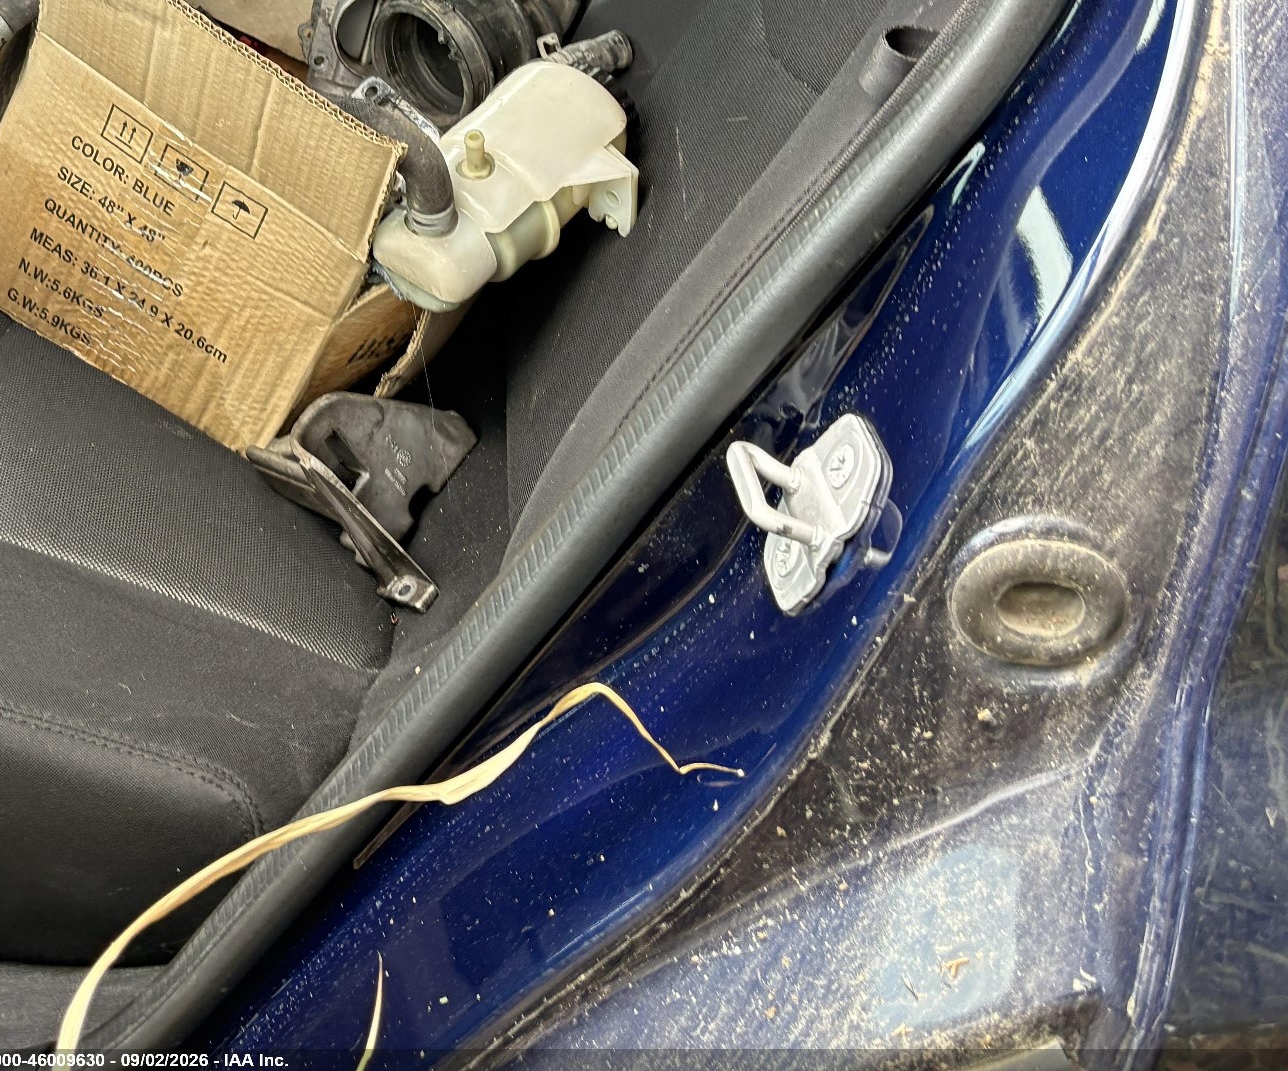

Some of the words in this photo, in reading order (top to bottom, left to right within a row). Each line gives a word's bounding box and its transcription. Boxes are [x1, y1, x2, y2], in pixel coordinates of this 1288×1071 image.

[57, 166, 96, 200] SIZE:
[124, 211, 137, 226] X
[71, 135, 129, 185] COLOR:
[132, 177, 175, 217] BLUE
[7, 287, 92, 346] G.W:5.9KGS
[18, 256, 105, 318] N.W:5.6KGS
[29, 227, 78, 267] MEAS:
[80, 260, 110, 286] 36.1
[114, 280, 127, 296] X
[128, 290, 159, 318] 249
[160, 312, 175, 328] X
[174, 322, 228, 364] 20.6cm
